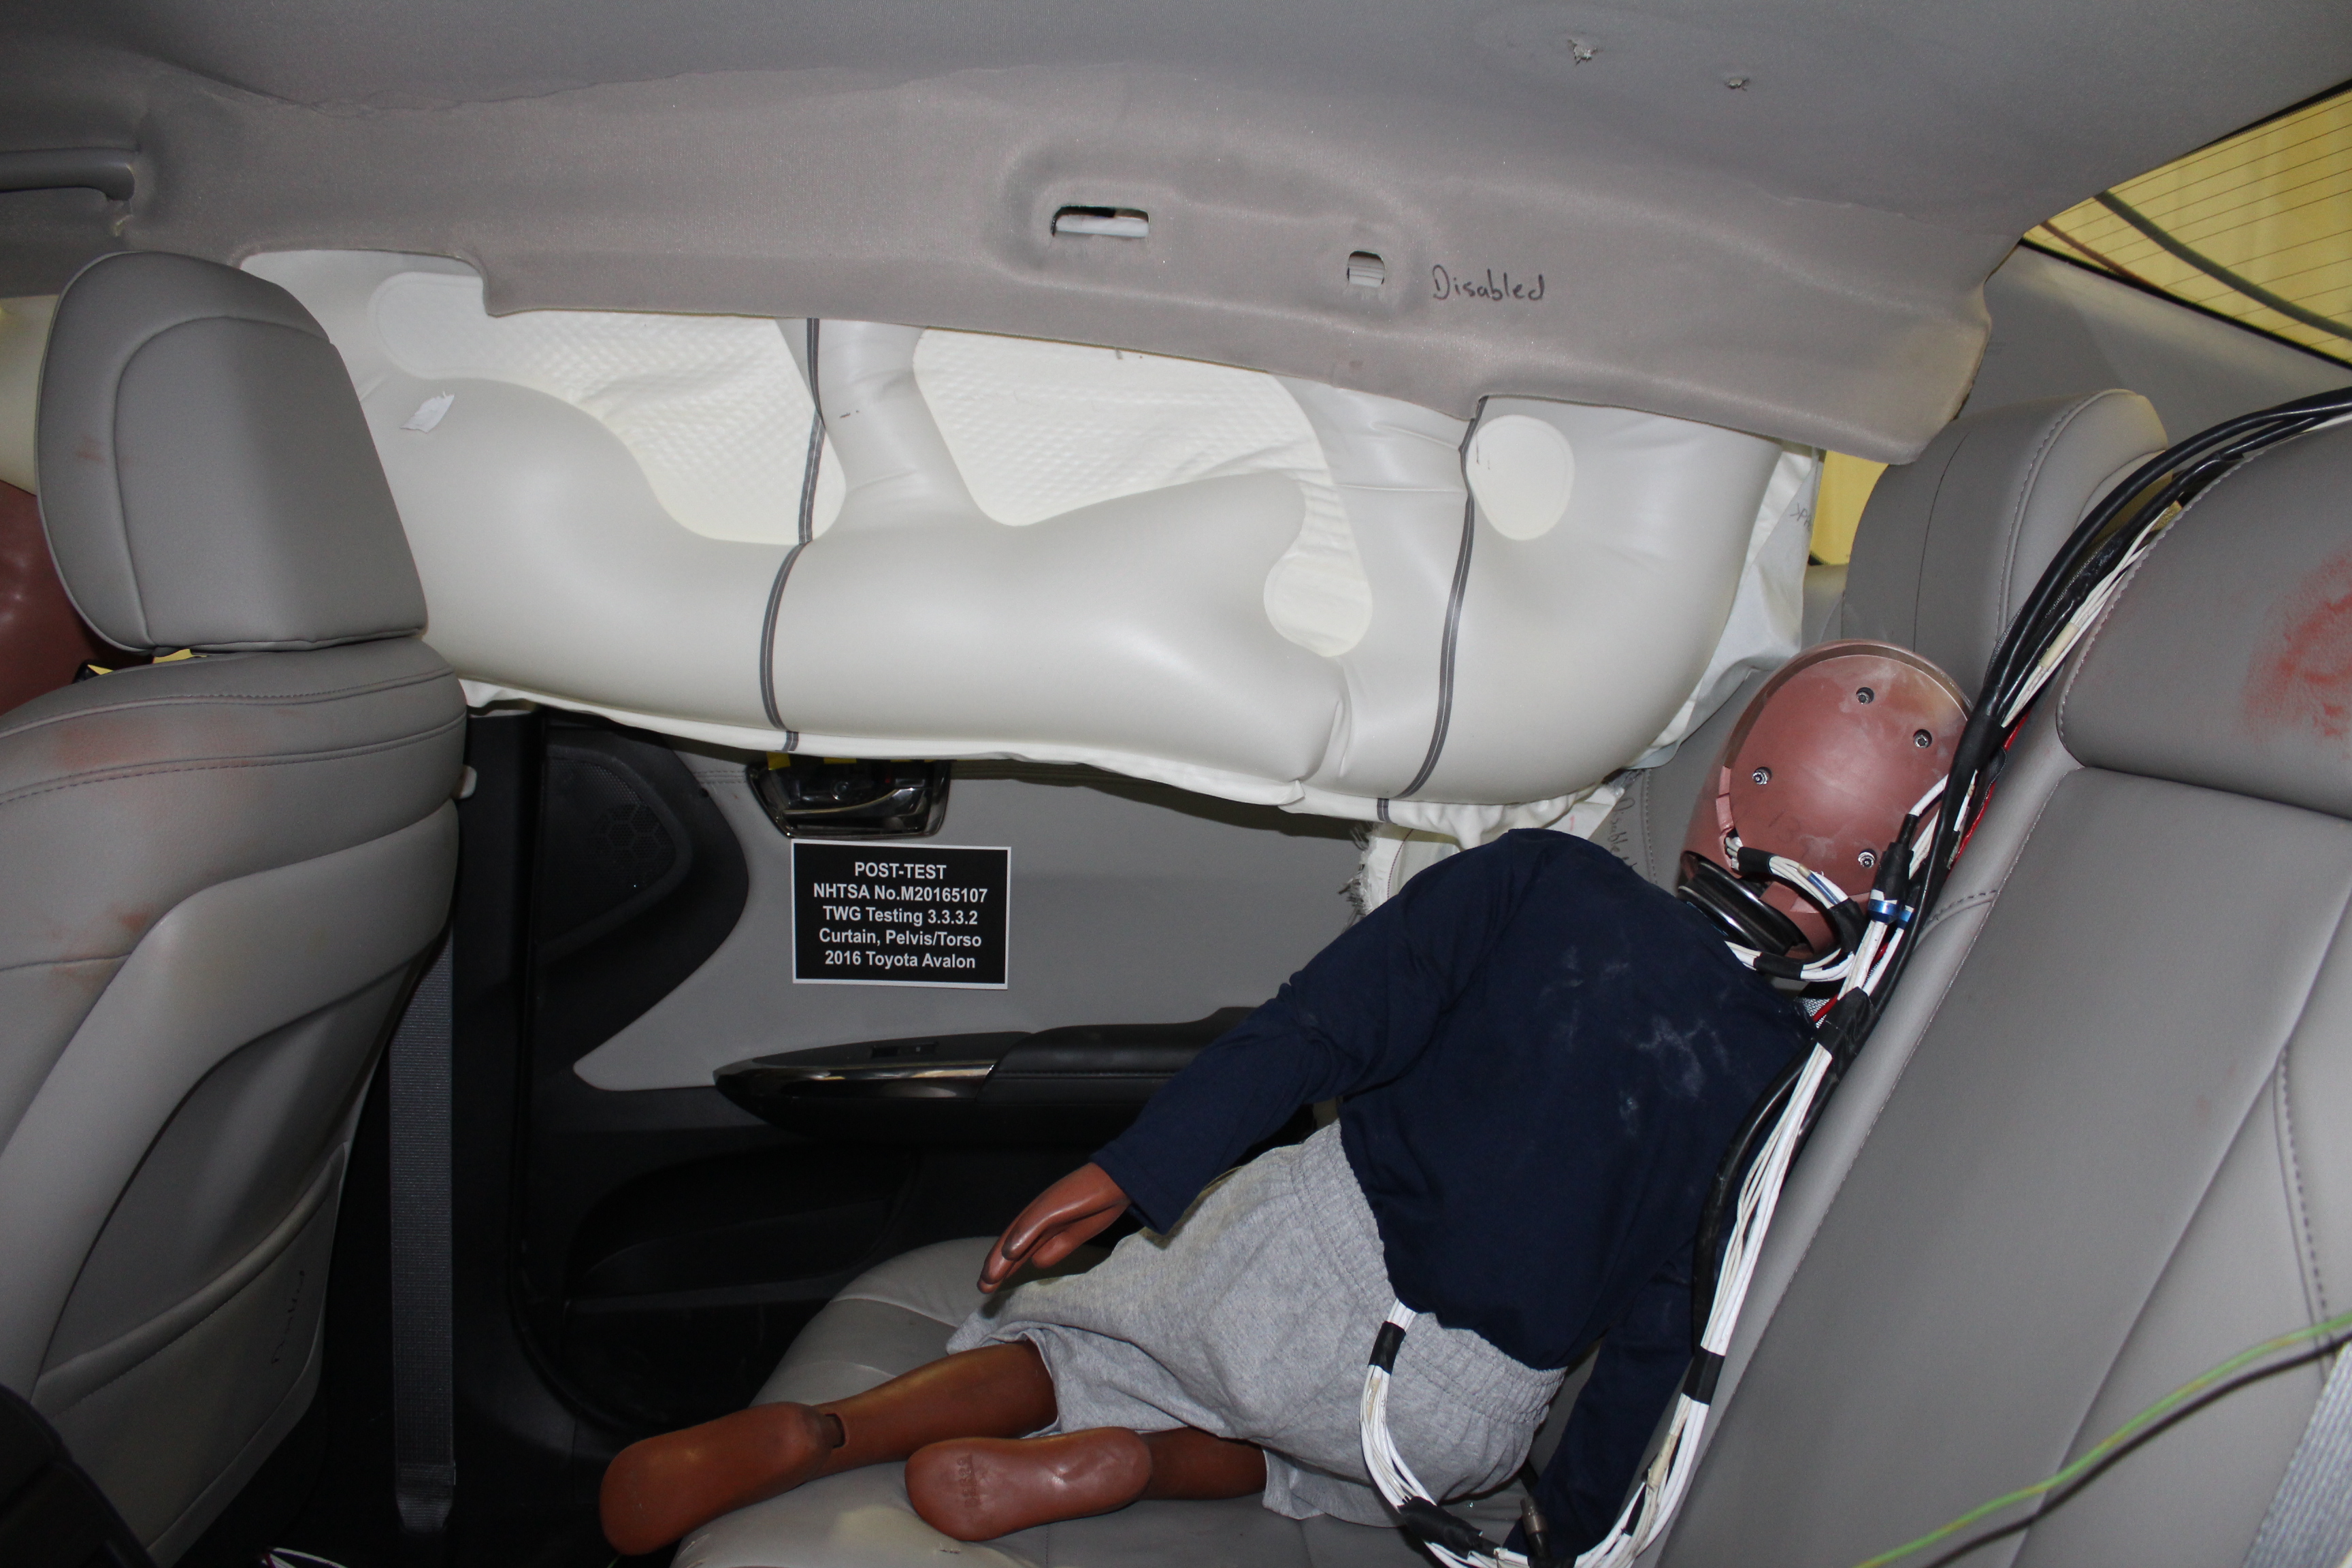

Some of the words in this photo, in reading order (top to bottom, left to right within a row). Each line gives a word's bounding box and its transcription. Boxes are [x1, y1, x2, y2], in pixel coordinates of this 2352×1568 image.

[1432, 264, 1545, 301] Disabled
[855, 862, 947, 879] POST-TEST
[814, 883, 870, 898] NHTSA
[875, 885, 987, 902] No.M20165107
[823, 906, 861, 921] TWG
[866, 907, 922, 926] Testing
[928, 909, 977, 924] 3.3.3.2
[819, 928, 880, 946] Curtain,
[886, 930, 981, 947] Pelvis/Torso
[826, 950, 861, 965] 2016
[866, 951, 917, 969] Toyota
[922, 953, 975, 968] Avalon
